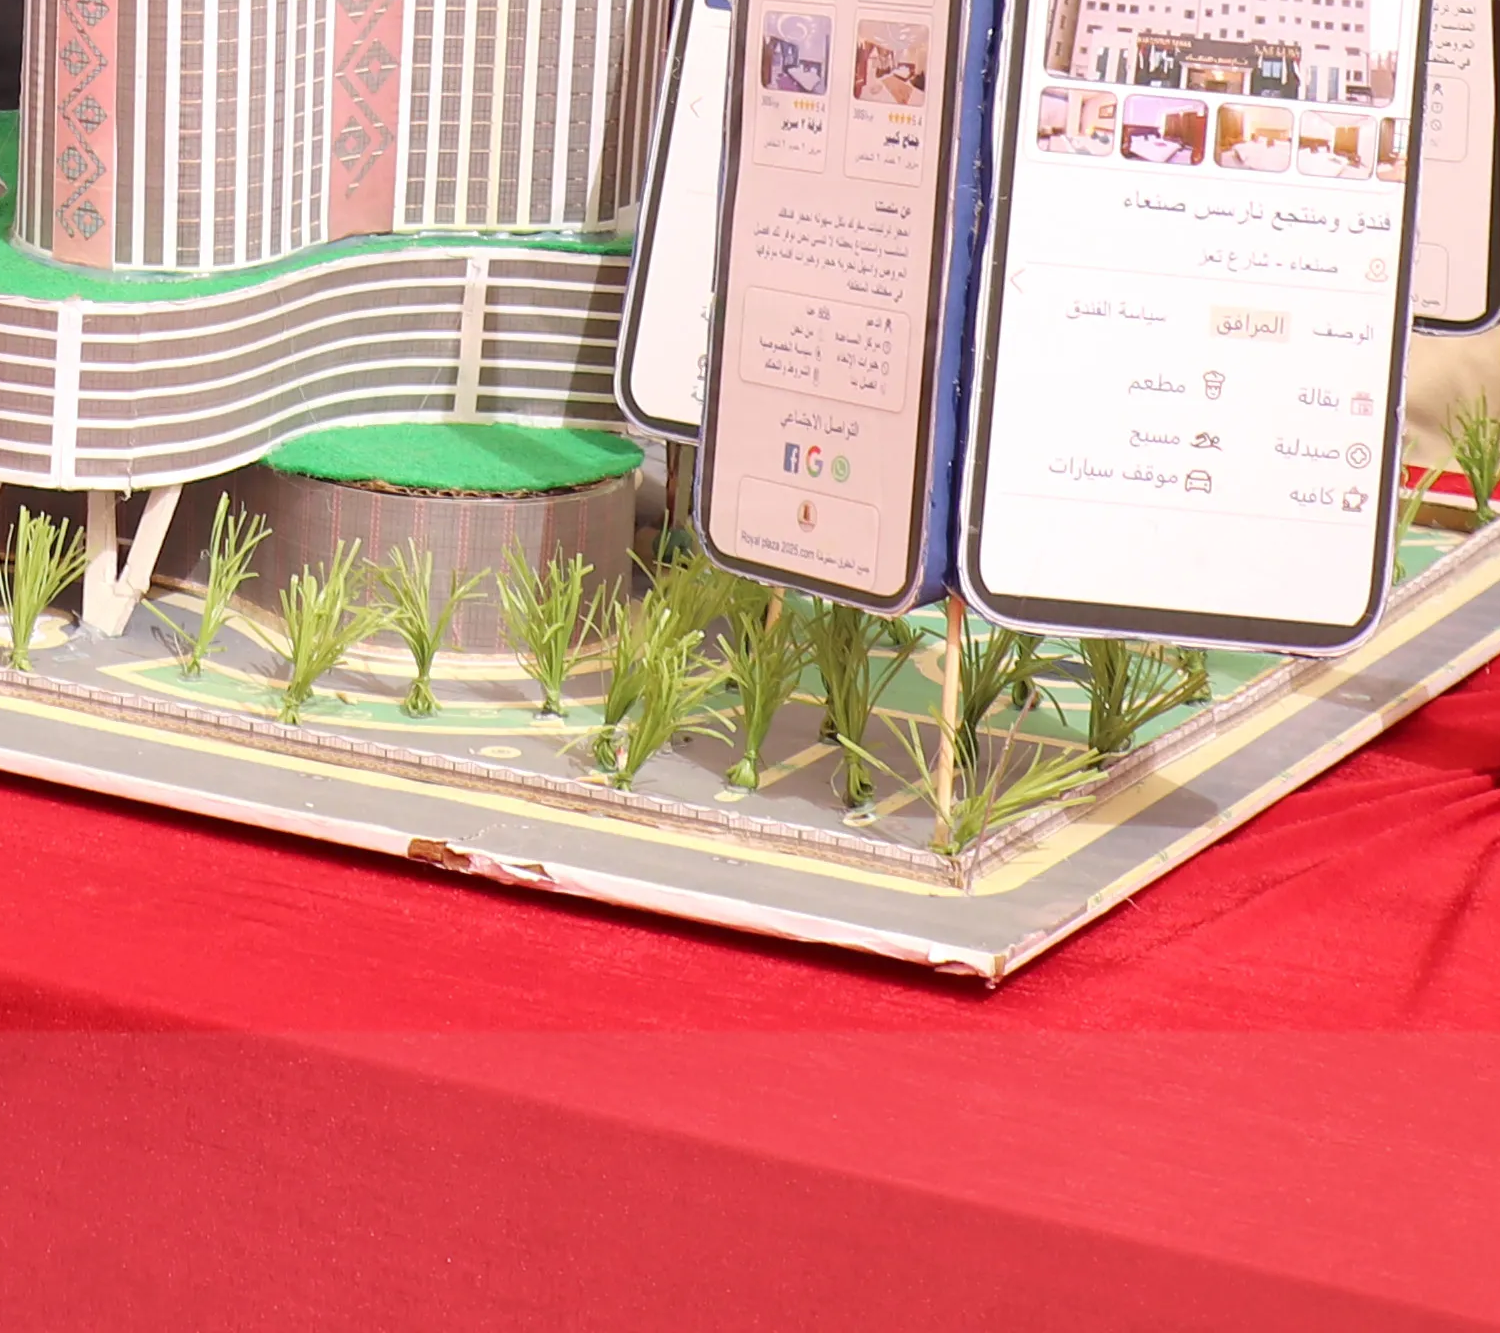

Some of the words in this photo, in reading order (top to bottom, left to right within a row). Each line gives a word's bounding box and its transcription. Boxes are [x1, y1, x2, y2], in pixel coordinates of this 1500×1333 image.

[1123, 190, 1186, 213] صنعاء
[1348, 213, 1391, 233] فندق
[1066, 300, 1111, 319] الفندق
[1216, 313, 1284, 338] المرافق
[1313, 324, 1374, 345] الوصف
[1128, 373, 1185, 394] مطعم
[1298, 386, 1339, 411] بقالة
[1129, 428, 1180, 447] مسبح
[1274, 436, 1340, 461] صيدلية
[1048, 457, 1114, 481] سيارات
[1122, 465, 1178, 488] موقف
[1289, 487, 1335, 507] كافيه
